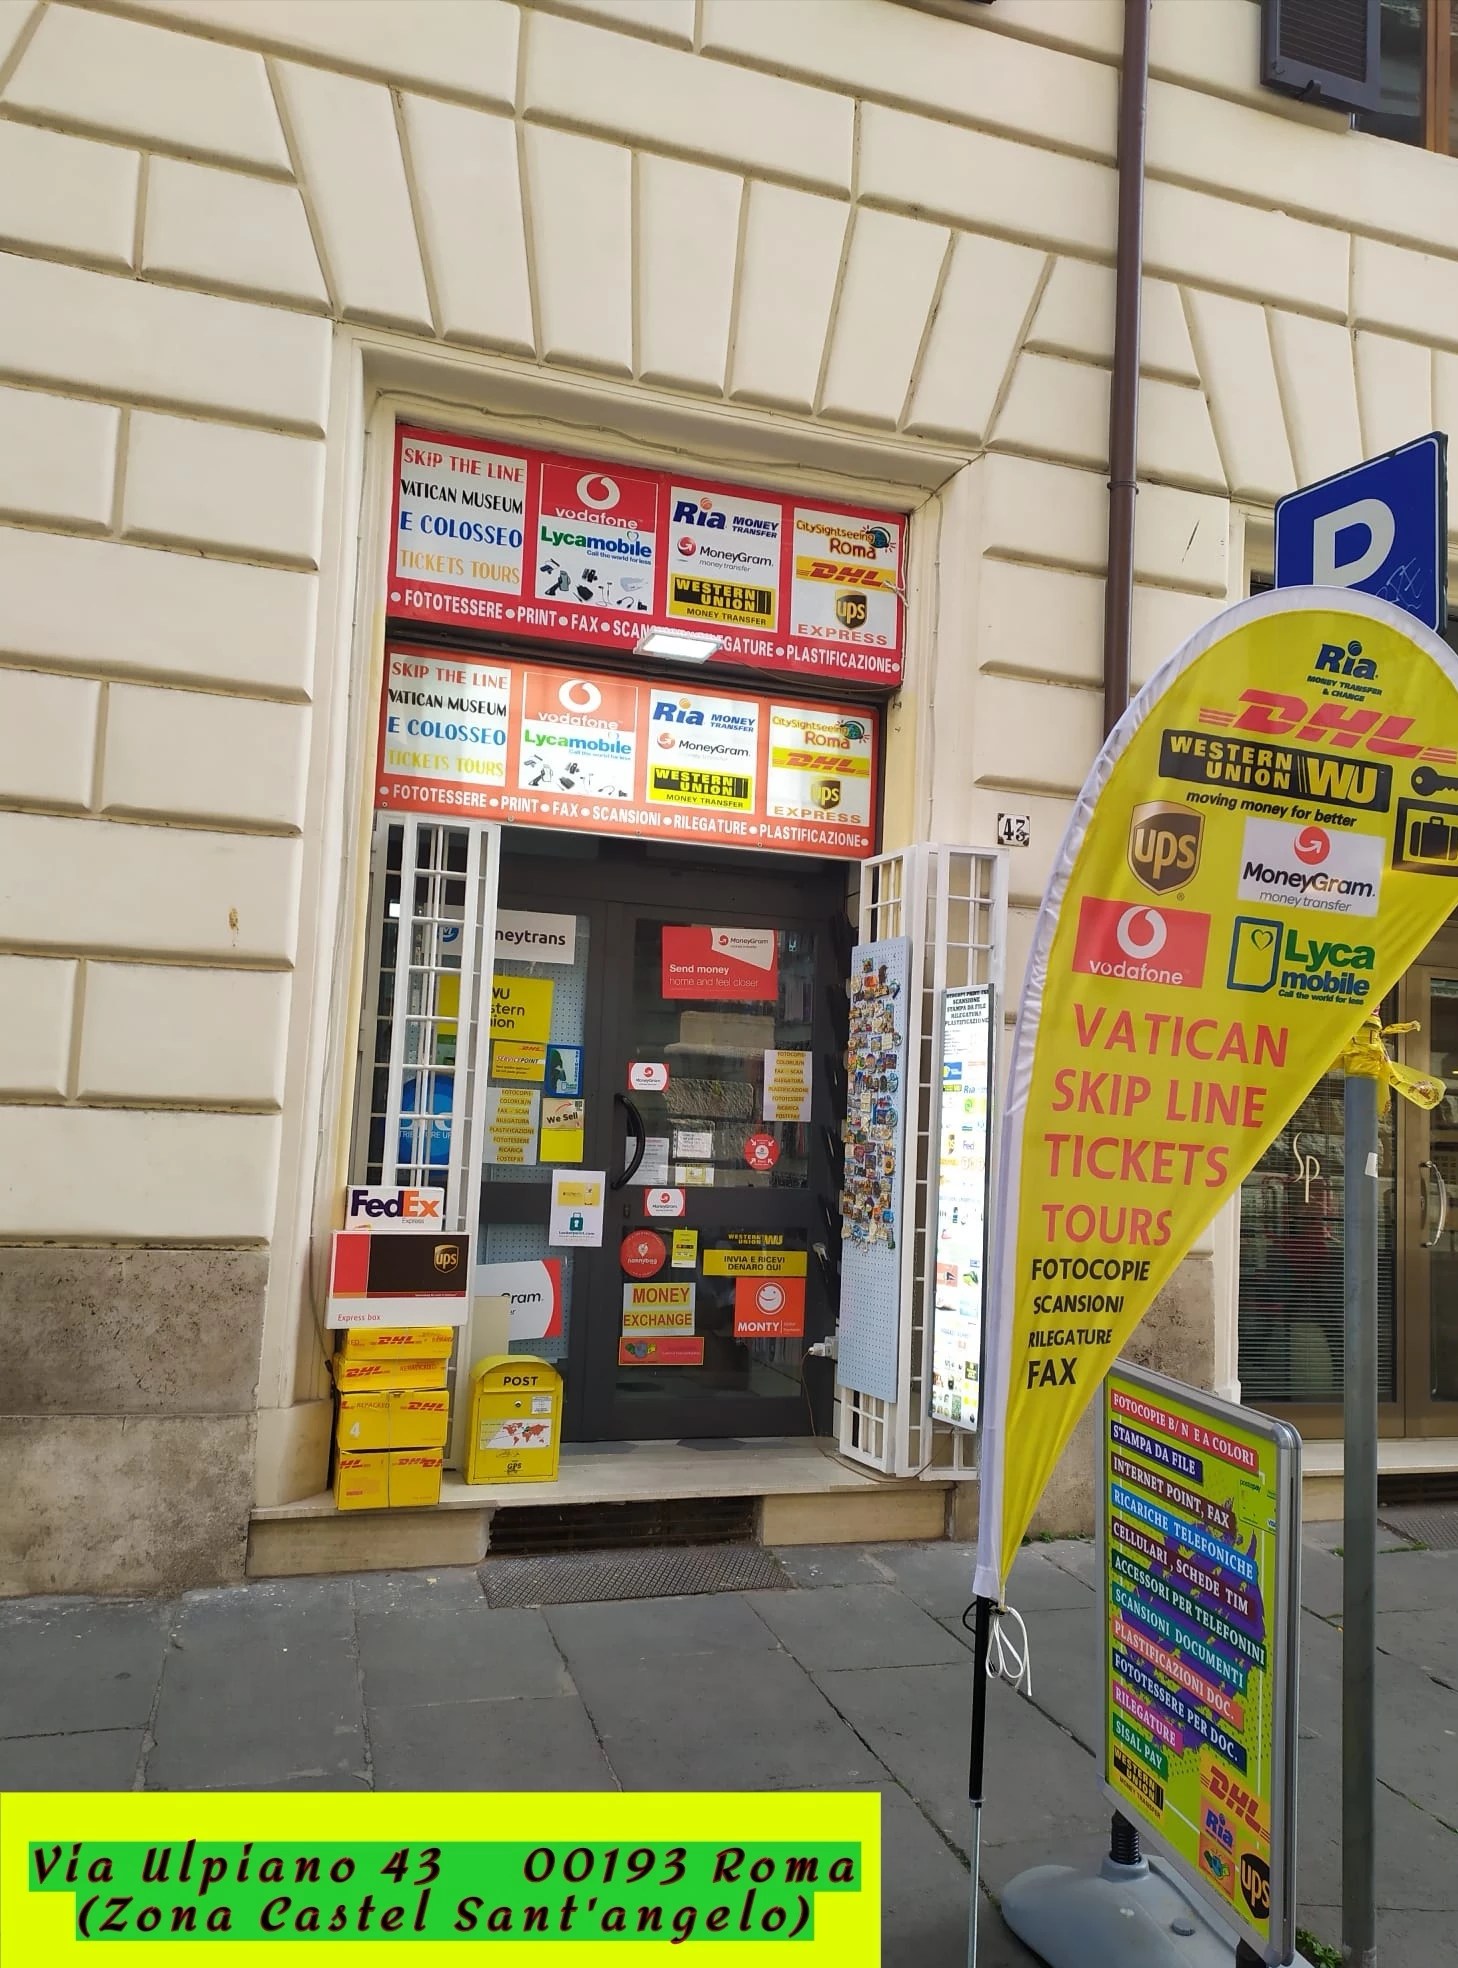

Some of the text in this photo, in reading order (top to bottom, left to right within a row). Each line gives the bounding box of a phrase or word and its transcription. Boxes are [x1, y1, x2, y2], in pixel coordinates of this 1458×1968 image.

[404, 448, 525, 483] SKIP THE LINE
[400, 479, 523, 515] VATICAN MUSEUM
[555, 507, 638, 530] vodafone
[673, 497, 779, 531] Ria MONEY
[400, 511, 522, 548] E COLOSSEO
[540, 526, 652, 558] Lycamobile
[732, 526, 778, 539] TRANSFER
[796, 520, 874, 542] CitySightseeing
[830, 537, 877, 560] Roma
[1313, 499, 1395, 588] P
[400, 550, 520, 584] TICKETS TOURS
[809, 562, 887, 587] DHL
[676, 578, 756, 600] WESTERN
[701, 594, 756, 611] UNION
[687, 608, 766, 625] MONEY TRANSFER
[404, 589, 891, 673] FOTOTESSERE PRINT FAX PLASTIFICAZIONE
[798, 624, 887, 645] EXPRESS
[1315, 640, 1379, 680] Ria
[392, 662, 508, 689] SKIP THE LINE
[1307, 676, 1383, 696] MONEY TRANSFER
[389, 689, 507, 717] VATICAN MUSEUM
[1322, 688, 1365, 702] & CHANGE
[538, 712, 618, 730] vodafone
[653, 698, 756, 726] Ria MONEY
[1233, 689, 1425, 759] DHL
[388, 716, 505, 746] E COLOSSEO
[711, 722, 754, 732] TRANSFER
[773, 716, 848, 736] CitySightseeing
[524, 729, 632, 755] Lycamobile
[805, 731, 850, 750] Roma
[388, 749, 504, 777] TICKETS TOURS
[1170, 736, 1378, 803] WESTERN WU
[1206, 761, 1290, 789] UNION
[655, 769, 733, 786] WESTERN
[680, 782, 733, 795] UNION
[666, 794, 743, 808] MONEY TRANSFER
[1186, 791, 1357, 827] moving money for better
[393, 784, 860, 847] FOTOTESSERE PRINT FAX SCANSIONI RILEGATURE PLASTIFICAZIONE
[774, 806, 862, 824] EXPRESS
[1003, 818, 1029, 841] 43
[1136, 827, 1197, 880] ups
[1260, 891, 1352, 912] money transfer
[495, 930, 566, 945] neytrans
[1285, 929, 1376, 972] Lyca
[670, 964, 729, 975] Send money
[670, 978, 694, 986] home
[697, 978, 712, 986] and
[1089, 960, 1183, 985] vodafone
[1280, 970, 1371, 996] mobile
[1278, 989, 1294, 998] Call
[1296, 991, 1309, 999] the
[1311, 992, 1333, 1002] world
[1074, 1004, 1289, 1067] VATICAN
[1053, 1068, 1267, 1128] SKIP LINE
[547, 1112, 578, 1124] We Sell
[1044, 1133, 1230, 1187] TICKETS
[351, 1190, 440, 1217] FedEx
[1042, 1204, 1173, 1246] TOURS
[1032, 1258, 1150, 1281] FOTOCOPIE
[633, 1288, 690, 1303] MONEY
[1033, 1295, 1124, 1314] SCANSIONI
[338, 1314, 364, 1322] Express
[623, 1314, 692, 1326] EXCHANGE
[738, 1322, 779, 1331] MONTY
[1028, 1329, 1112, 1349] RILEGATURE
[504, 1376, 538, 1385] POST
[1027, 1357, 1078, 1389] FAX
[350, 1422, 360, 1437] 4
[1113, 1393, 1166, 1427] FOTOCOPIE
[1195, 1428, 1200, 1441] E
[1203, 1431, 1209, 1445] A
[1212, 1436, 1254, 1466] COLORI
[1113, 1425, 1196, 1474] STAMPA DA FILE
[1113, 1456, 1163, 1493] INTERNET
[1208, 1504, 1230, 1528] FAX
[1114, 1490, 1253, 1579] RICARICHE TELEFONICHE
[1176, 1559, 1219, 1597] SCHEDE
[1226, 1588, 1248, 1615] TIM
[1115, 1557, 1265, 1665] ACCESSORI PER TELEFONINI
[1115, 1588, 1243, 1689] SCANSIONI DOCUMENTI
[1115, 1621, 1234, 1719] PLASTIFICAZIONI DOC.
[1115, 1654, 1238, 1762] FOTOTESSERE PER DOC.
[1115, 1687, 1176, 1747] RILEGATURE
[1116, 1723, 1163, 1770] SISAL PAY
[1209, 1766, 1261, 1834] DHL
[1205, 1808, 1233, 1849] Ria
